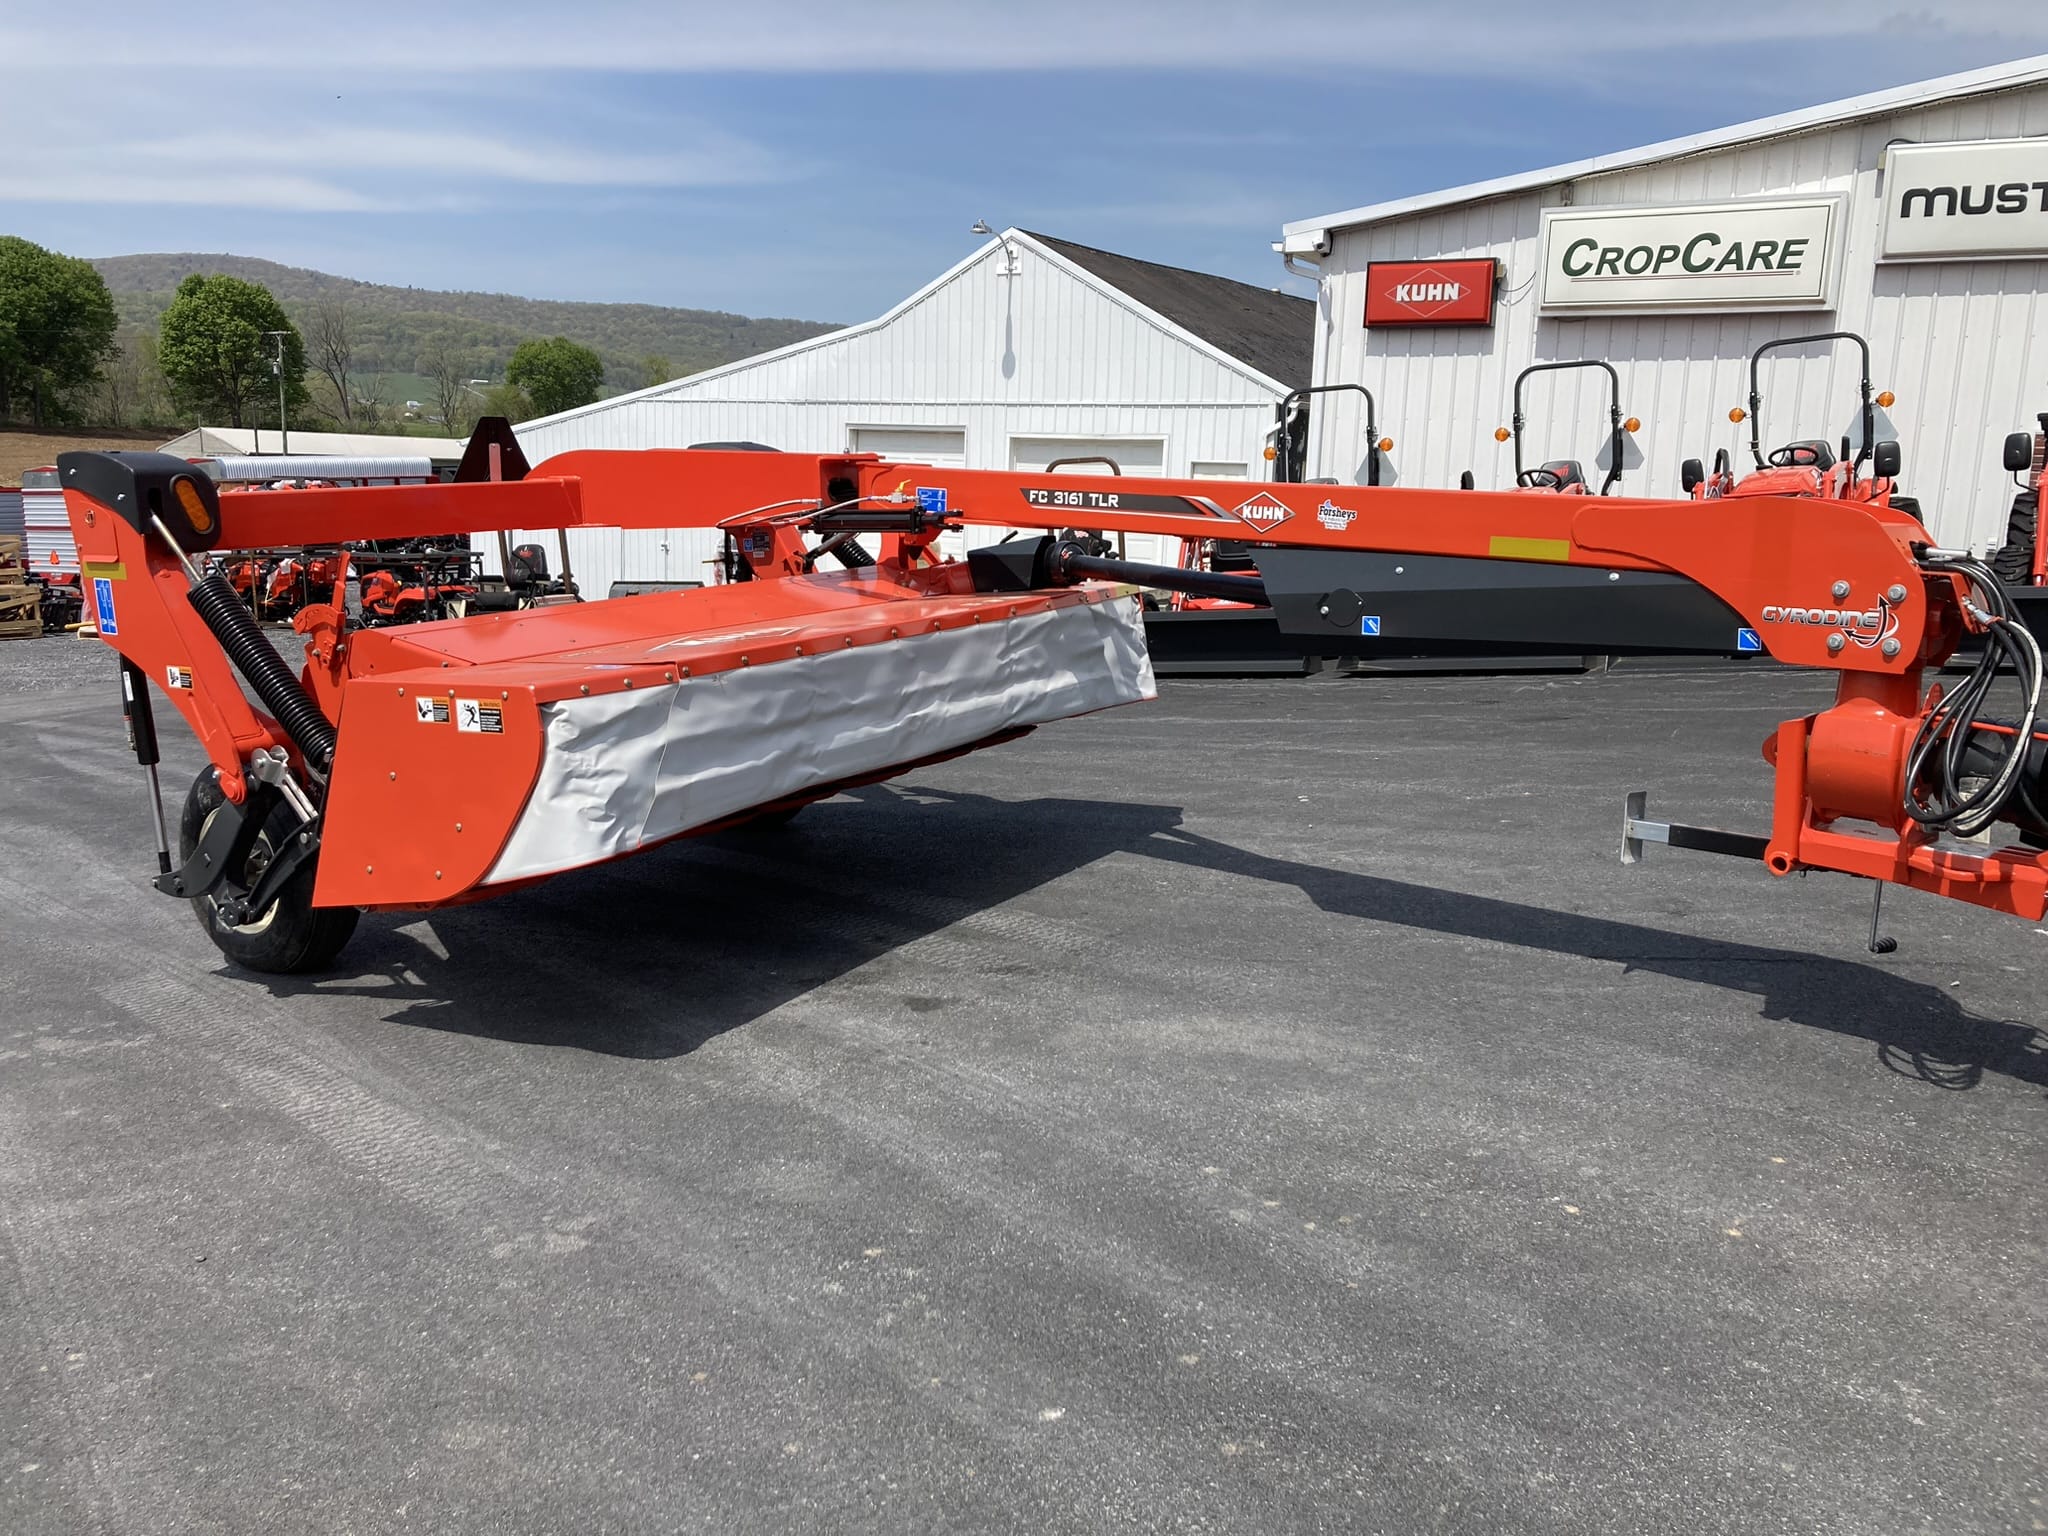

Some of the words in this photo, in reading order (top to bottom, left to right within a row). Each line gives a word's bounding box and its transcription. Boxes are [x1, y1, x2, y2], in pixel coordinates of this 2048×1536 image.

[1395, 282, 1460, 303] KUHN
[1029, 490, 1048, 503] FC
[1054, 491, 1083, 505] 3161
[1089, 493, 1119, 507] TLR
[1242, 504, 1285, 521] KUHN
[1319, 506, 1356, 520] Forsheys
[1762, 605, 1880, 628] GYRODINE
